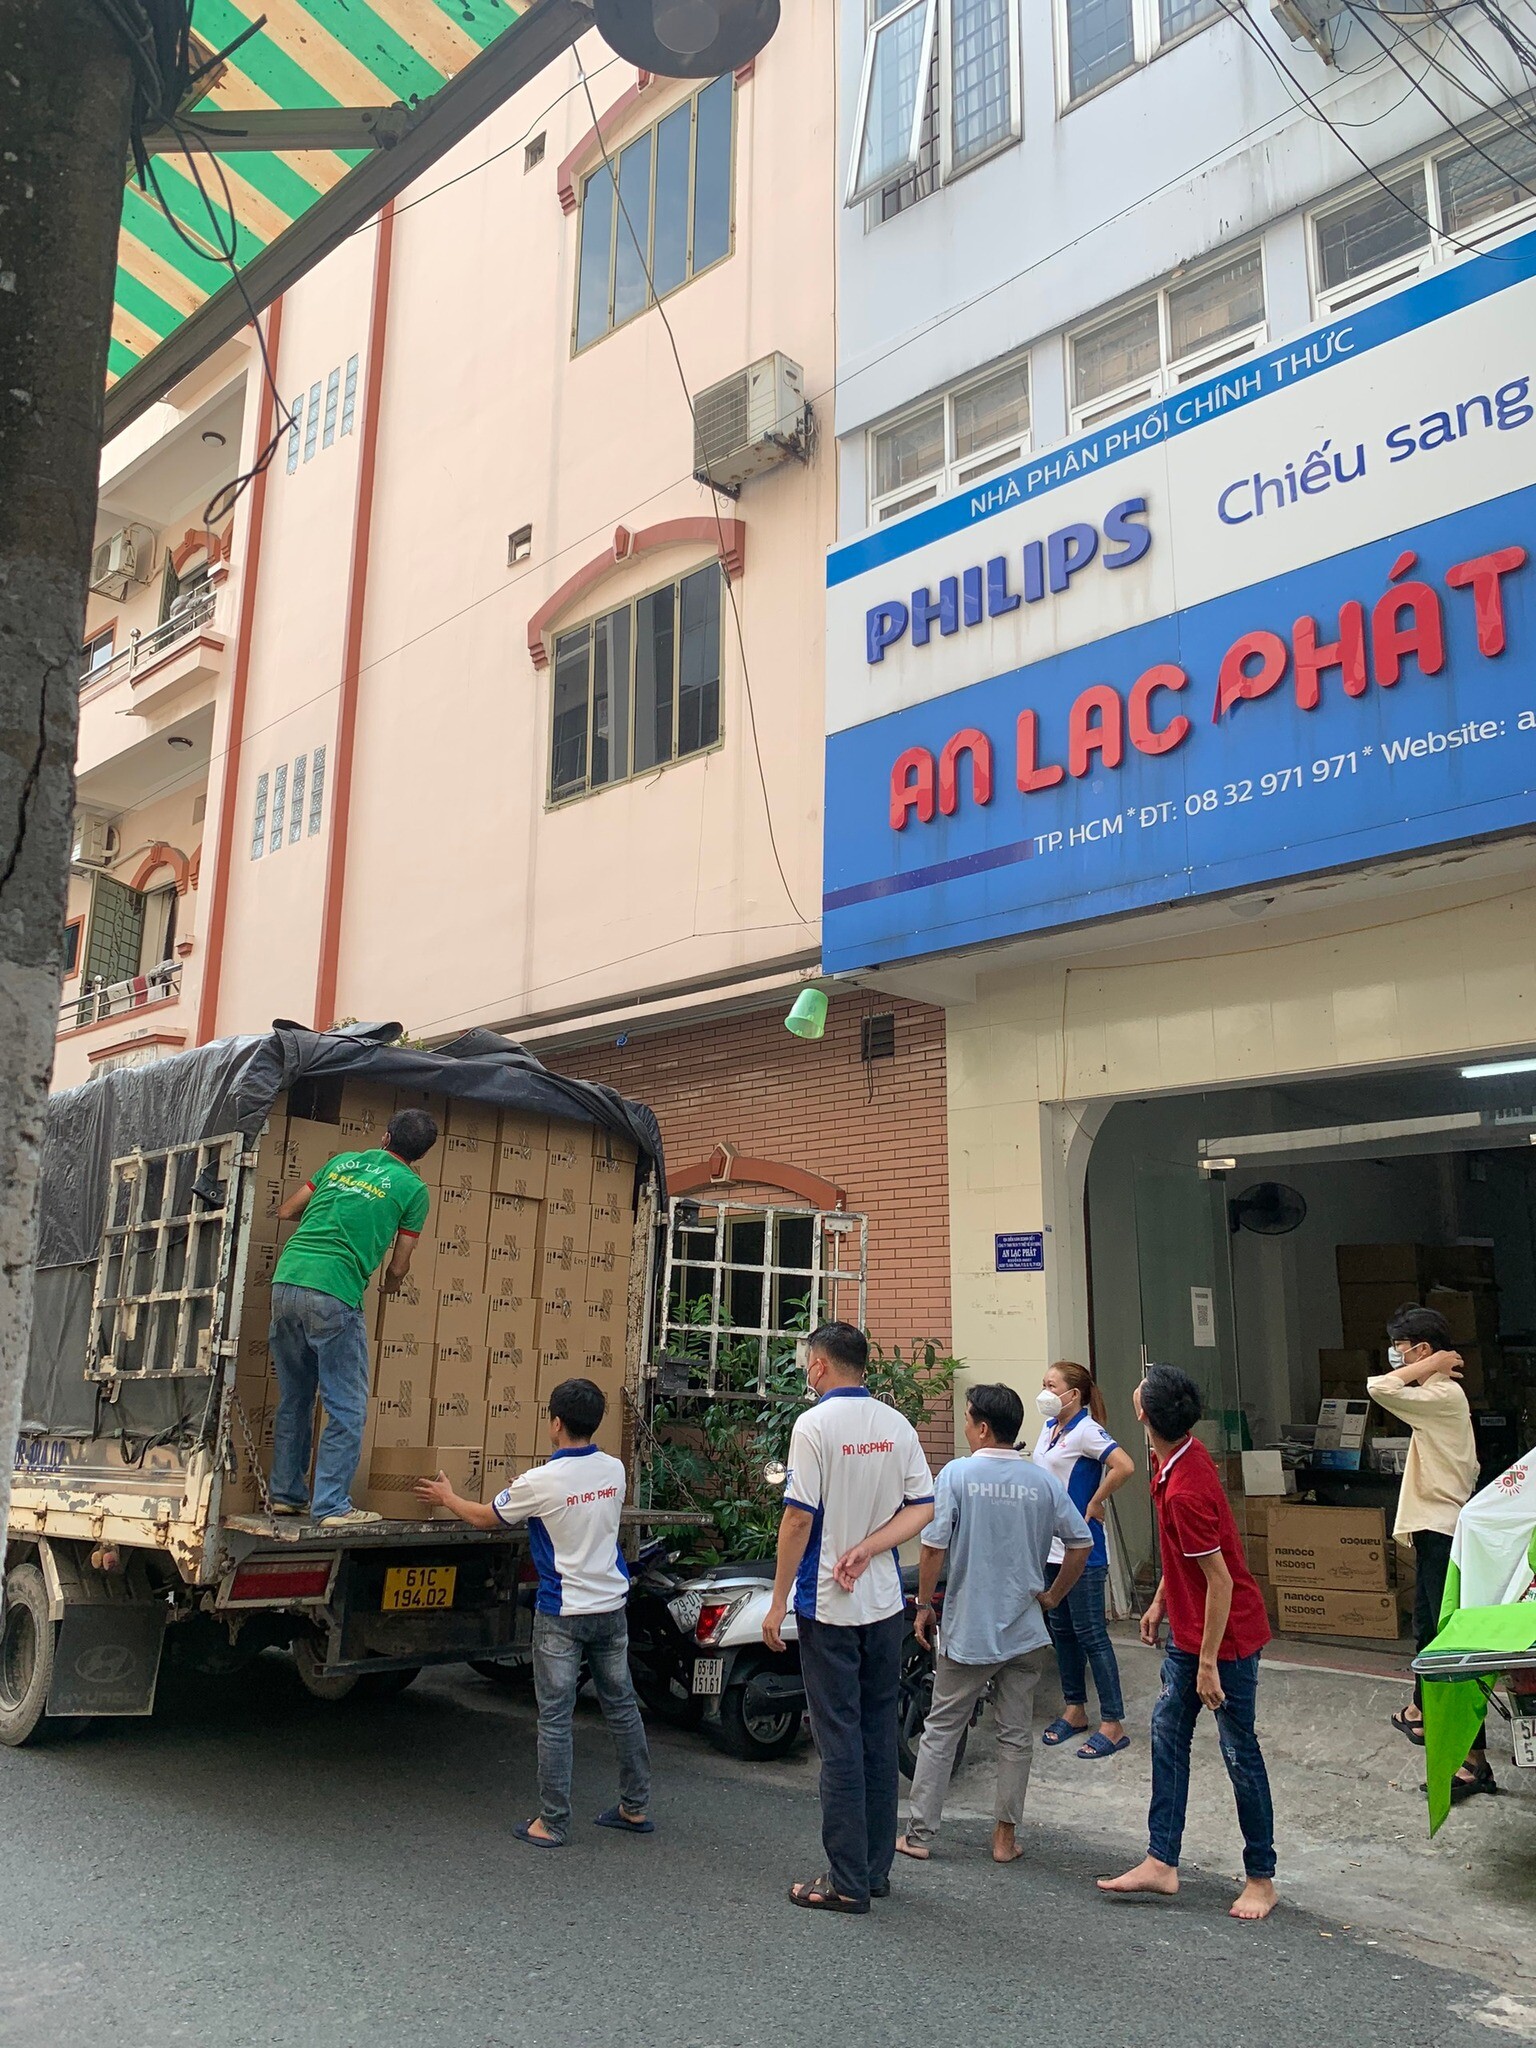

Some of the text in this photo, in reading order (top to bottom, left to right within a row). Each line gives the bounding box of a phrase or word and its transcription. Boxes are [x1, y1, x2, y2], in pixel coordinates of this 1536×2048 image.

[970, 327, 1355, 518] NHÀ PHÂN PHỐI CHÍNH THỨC
[1217, 375, 1534, 525] Chiếu sang
[866, 497, 1151, 665] PHILIPS
[889, 728, 993, 831] AN
[1211, 545, 1529, 726] PHÁT
[1034, 830, 1063, 855] TP.
[1069, 814, 1123, 847] HCM
[1185, 790, 1218, 815] 08
[1223, 781, 1254, 807] 32
[1260, 766, 1303, 796] 971
[1312, 752, 1357, 783] 971
[1381, 720, 1506, 765] Website:
[870, 1439, 894, 1453] PHÁT
[597, 1486, 617, 1500] PHÁT
[967, 1482, 1039, 1501] PHILIPS
[394, 1588, 447, 1607] 194.02
[406, 1569, 437, 1587] 61C
